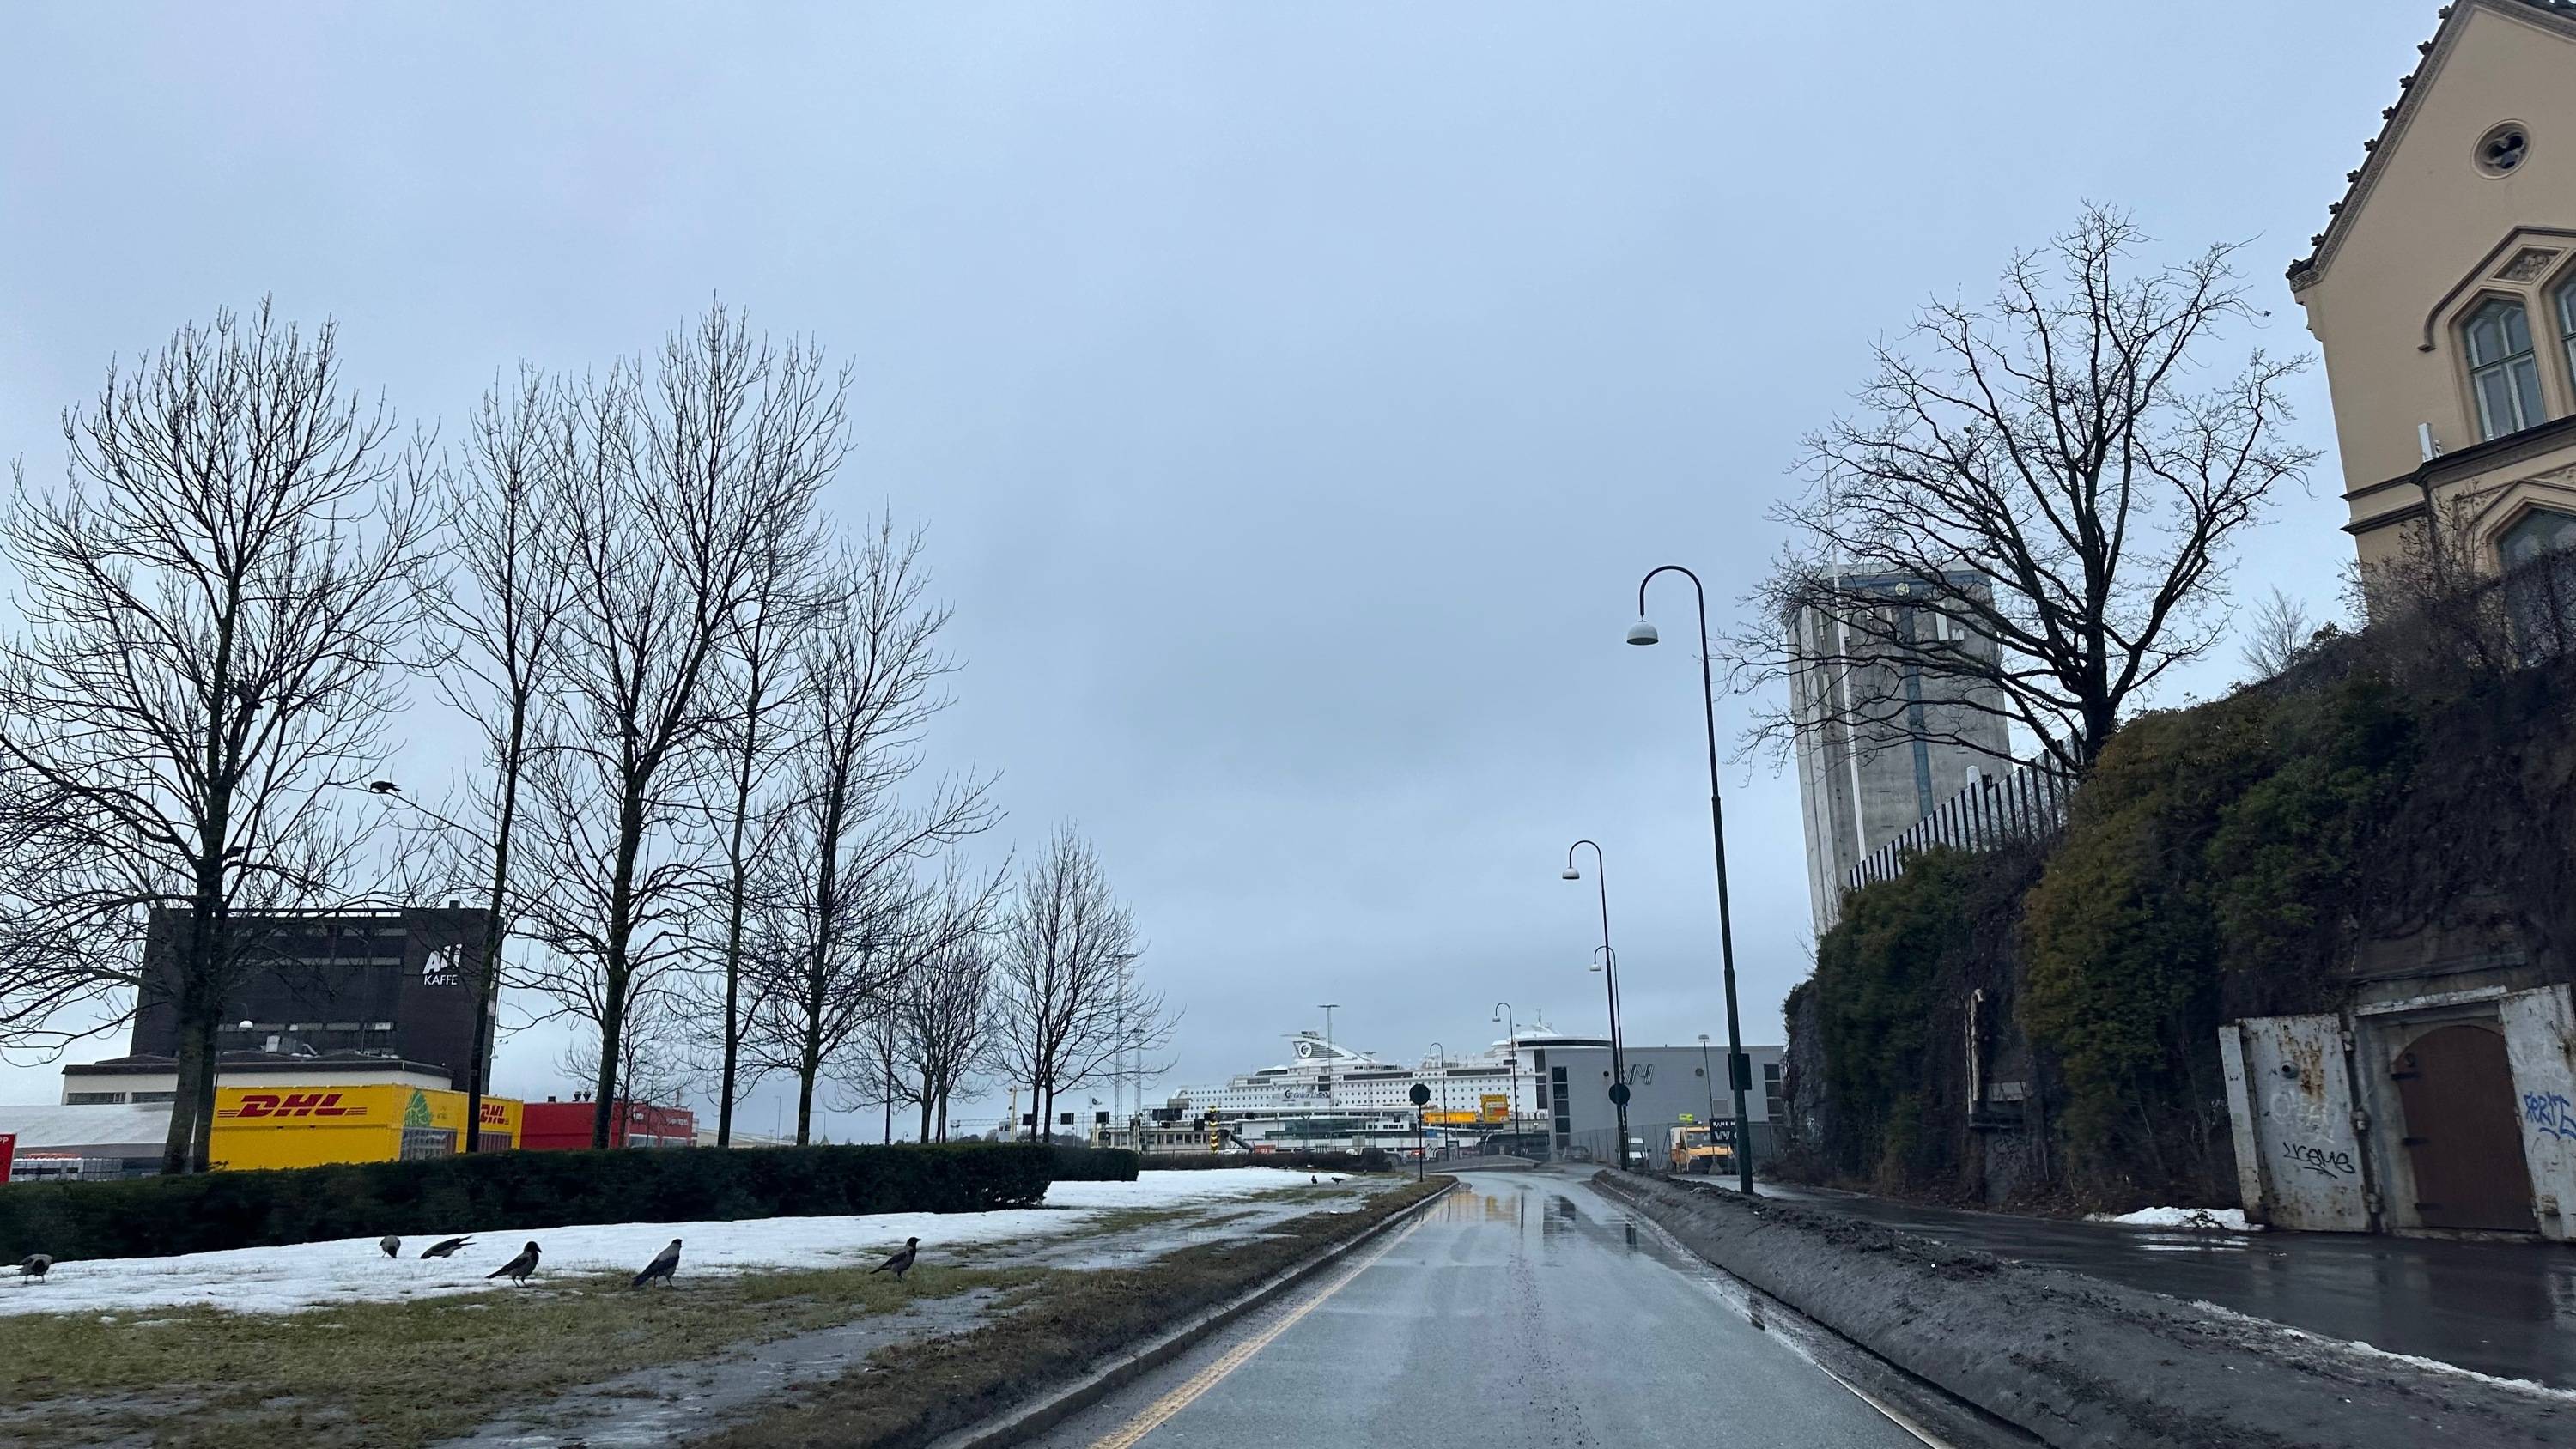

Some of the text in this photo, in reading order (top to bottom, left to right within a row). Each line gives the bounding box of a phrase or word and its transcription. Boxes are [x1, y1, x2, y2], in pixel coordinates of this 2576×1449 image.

[423, 974, 459, 985] KAFFE
[236, 1094, 347, 1117] DHL
[480, 1104, 506, 1124] DHL
